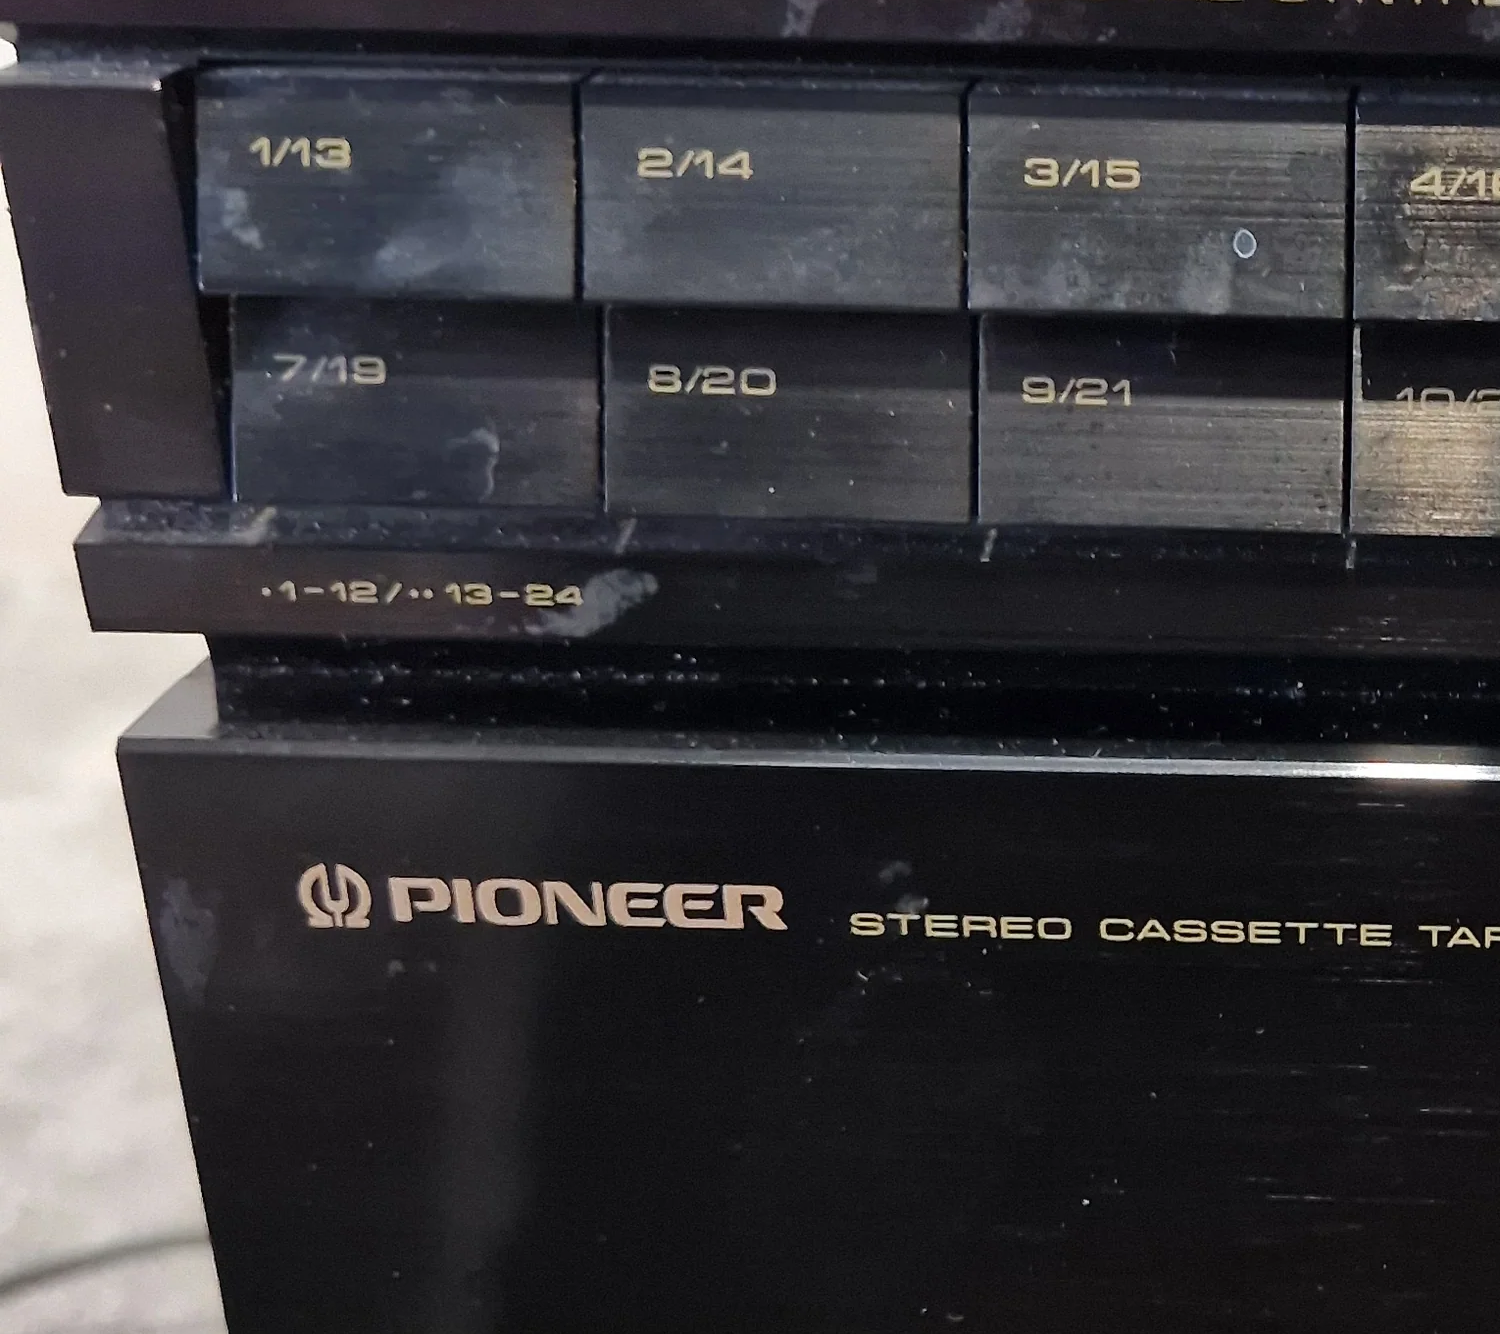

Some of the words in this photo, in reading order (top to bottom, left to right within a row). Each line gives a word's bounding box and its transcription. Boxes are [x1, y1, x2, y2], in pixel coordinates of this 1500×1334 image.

[249, 136, 352, 170] 1/13
[637, 147, 754, 180] 2/14
[1024, 157, 1141, 189] 3/15
[273, 354, 386, 385] 7/19
[647, 365, 777, 396] 8/20
[1020, 376, 1136, 408] 9/21
[387, 876, 788, 931] PIONEER
[849, 908, 1072, 940] STEREO
[1099, 917, 1393, 947] CASSETTE
